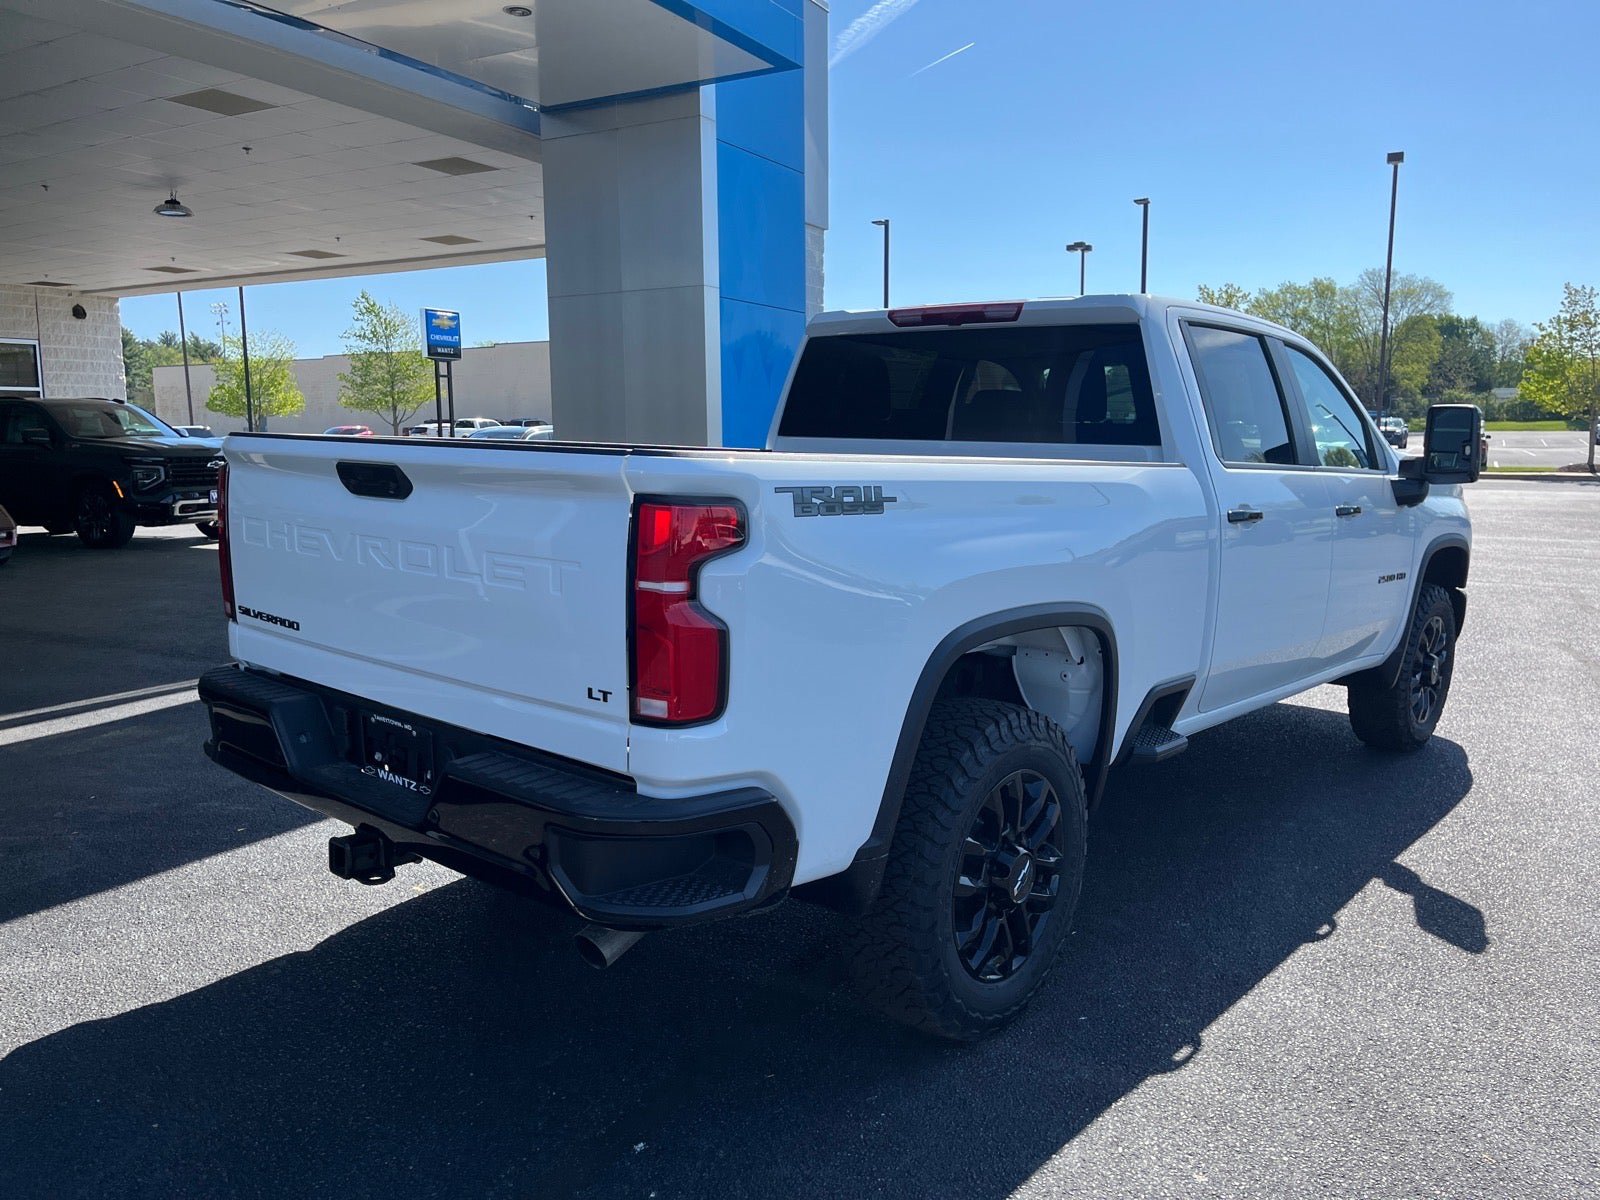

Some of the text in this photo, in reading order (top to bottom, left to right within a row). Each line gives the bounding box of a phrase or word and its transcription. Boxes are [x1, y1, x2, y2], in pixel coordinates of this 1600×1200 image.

[774, 485, 897, 503] TRAIL
[794, 501, 884, 517] BOSS
[242, 515, 582, 596] CHEVROLET
[238, 605, 300, 631] SILVERADO
[587, 686, 613, 703] LT
[377, 768, 418, 792] WANTZ
